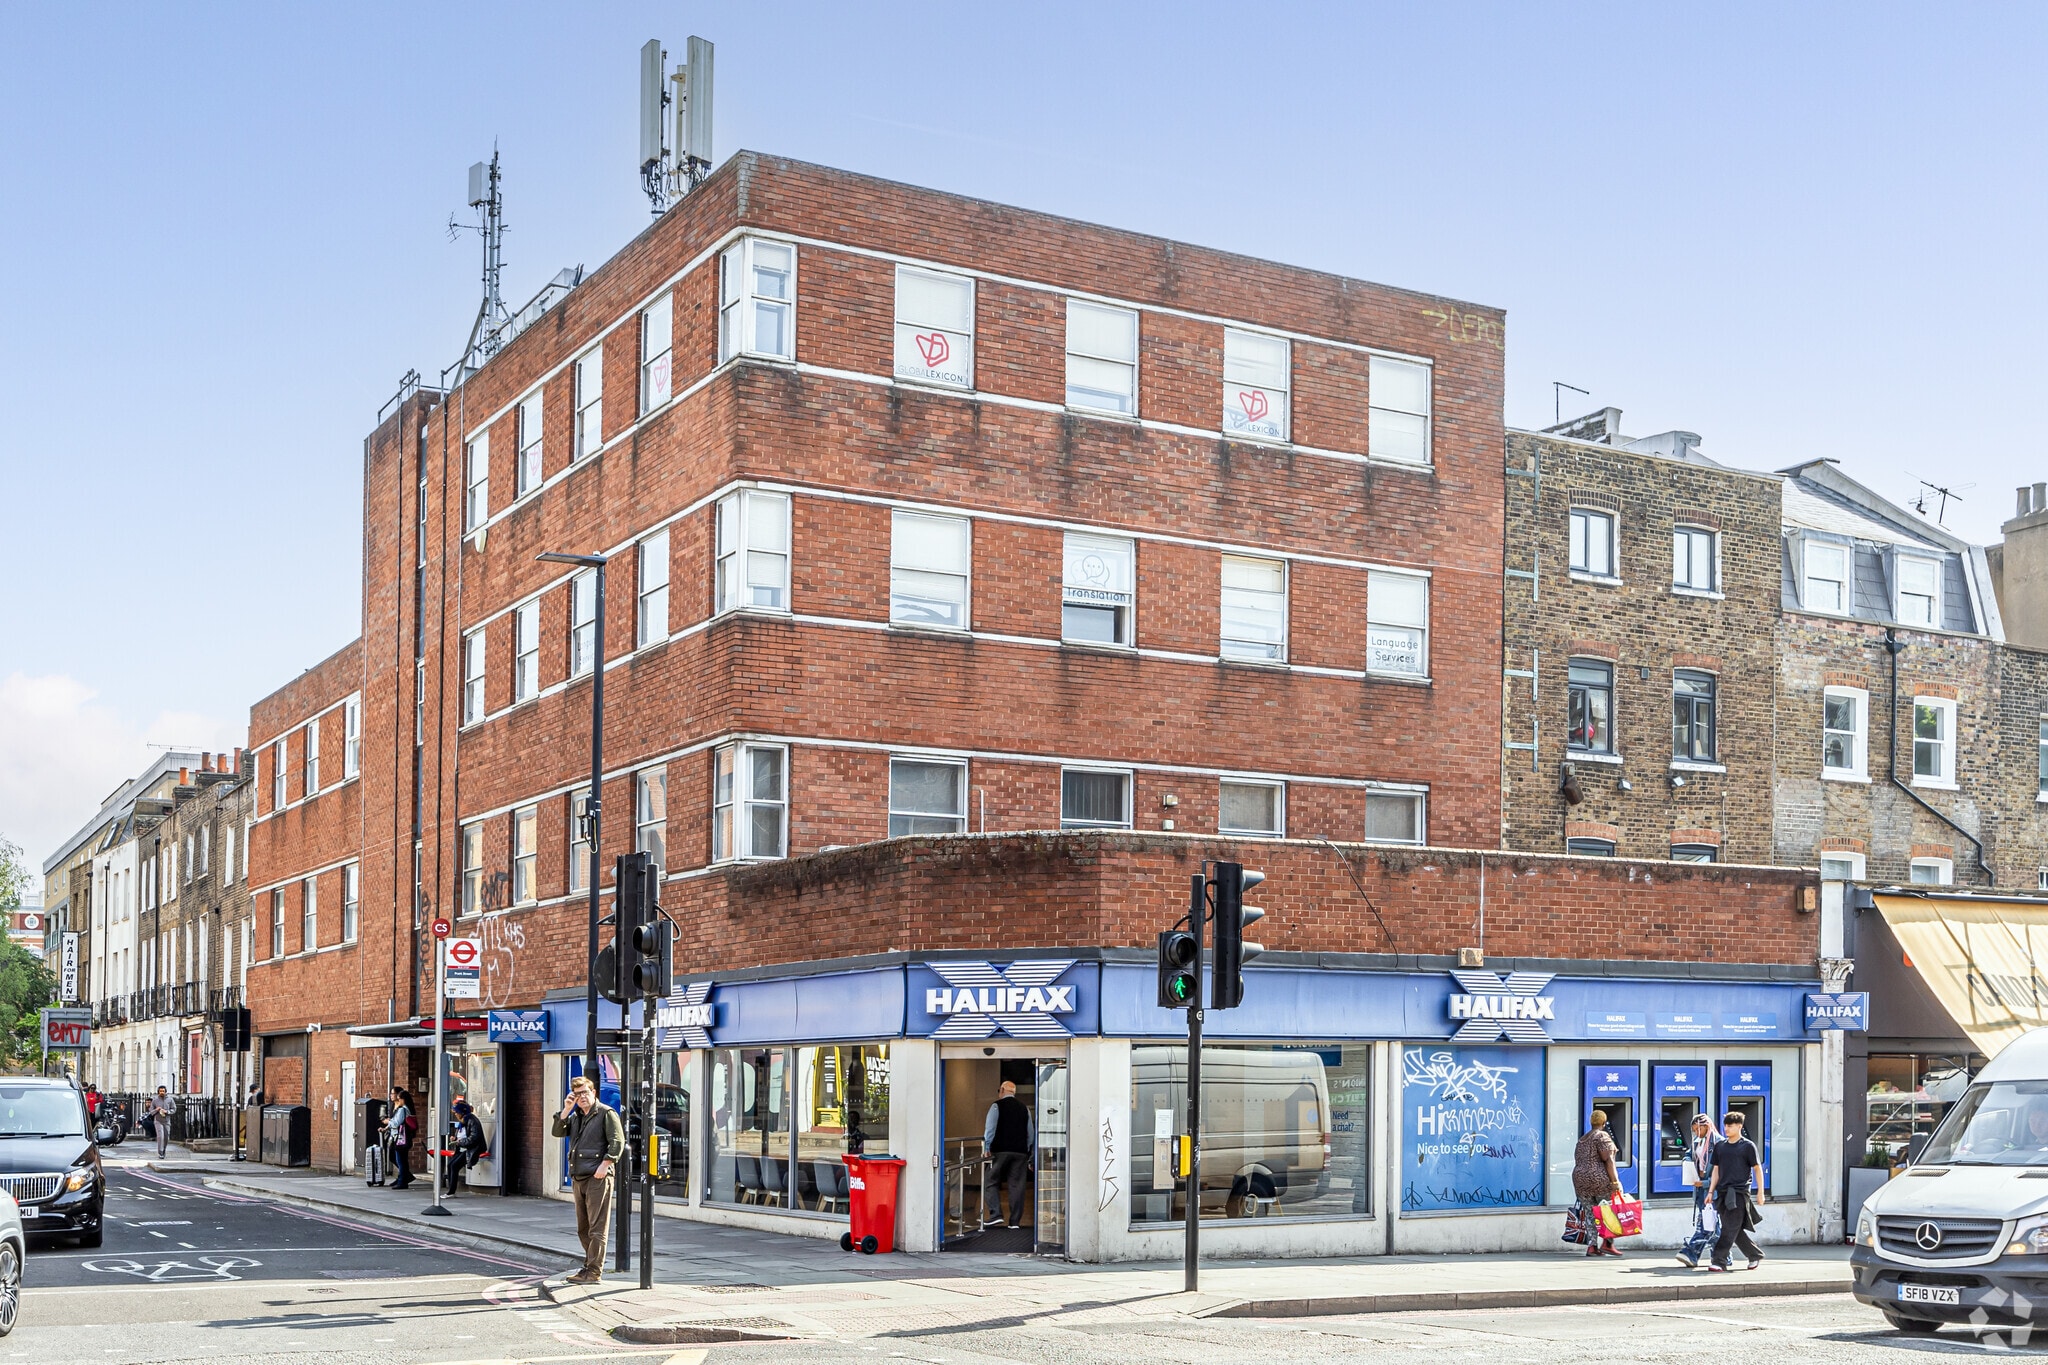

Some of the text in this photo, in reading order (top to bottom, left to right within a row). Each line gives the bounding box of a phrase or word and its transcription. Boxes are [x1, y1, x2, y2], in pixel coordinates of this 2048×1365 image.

[897, 364, 963, 382] GLOBALEXICON
[1067, 587, 1126, 602] Translation
[1371, 636, 1419, 651] Language
[1375, 650, 1416, 664] Services
[434, 923, 448, 933] CS
[925, 986, 1074, 1014] HALIFAX
[1450, 994, 1556, 1020] HALIFAX
[657, 1004, 712, 1028] HALIFAX
[1806, 1006, 1862, 1017] HALIFAX
[490, 1021, 546, 1032] HALIFAX
[1597, 1084, 1628, 1092] cash machine
[1332, 1110, 1349, 1120] Need
[1417, 1103, 1444, 1136] Hi
[1417, 1142, 1439, 1155] Nice
[1440, 1144, 1451, 1155] to
[1452, 1145, 1468, 1155] see
[1617, 1211, 1626, 1219] Big
[1905, 1287, 1954, 1302] SF18 VZX
